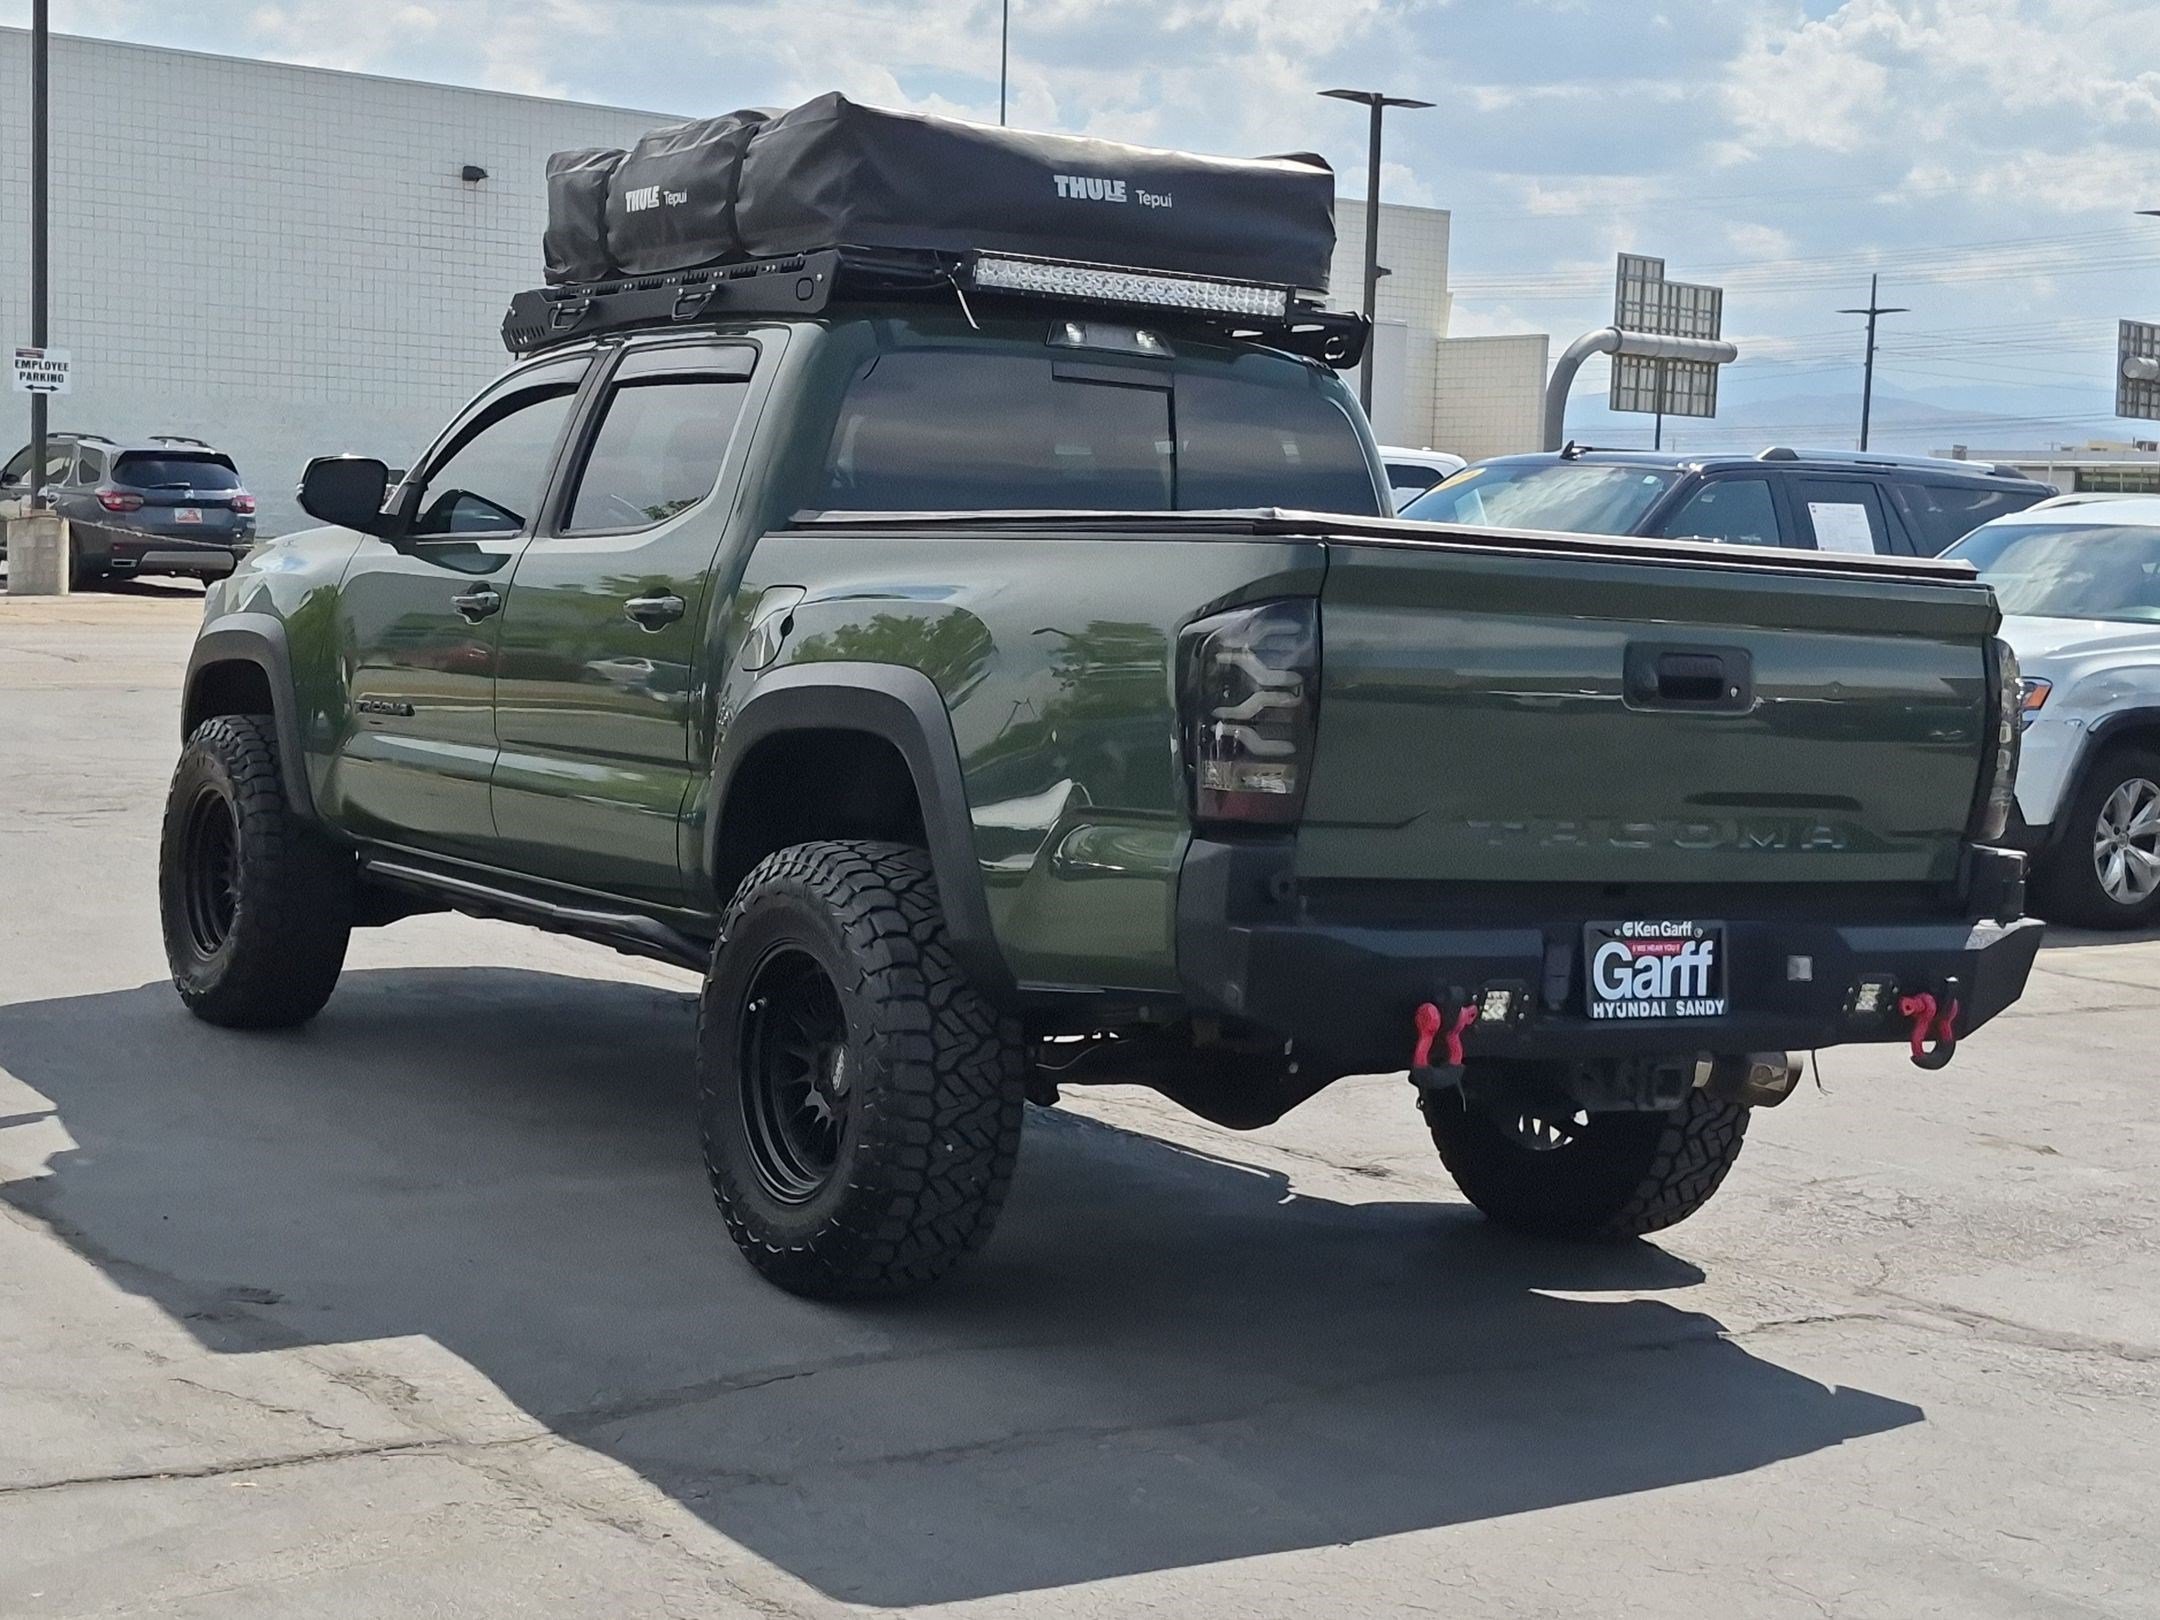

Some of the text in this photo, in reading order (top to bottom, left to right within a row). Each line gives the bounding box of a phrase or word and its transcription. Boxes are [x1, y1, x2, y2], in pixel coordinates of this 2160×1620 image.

[625, 185, 687, 213] THULE Tepui
[1053, 174, 1173, 208] THULE Tepui
[14, 359, 70, 372] EMPLOYEE
[19, 371, 65, 383] PARKING
[1634, 921, 1692, 937] Ken Garff
[1593, 940, 1714, 1000] Garff
[1593, 999, 1725, 1019] HYUNDAI SANDY
